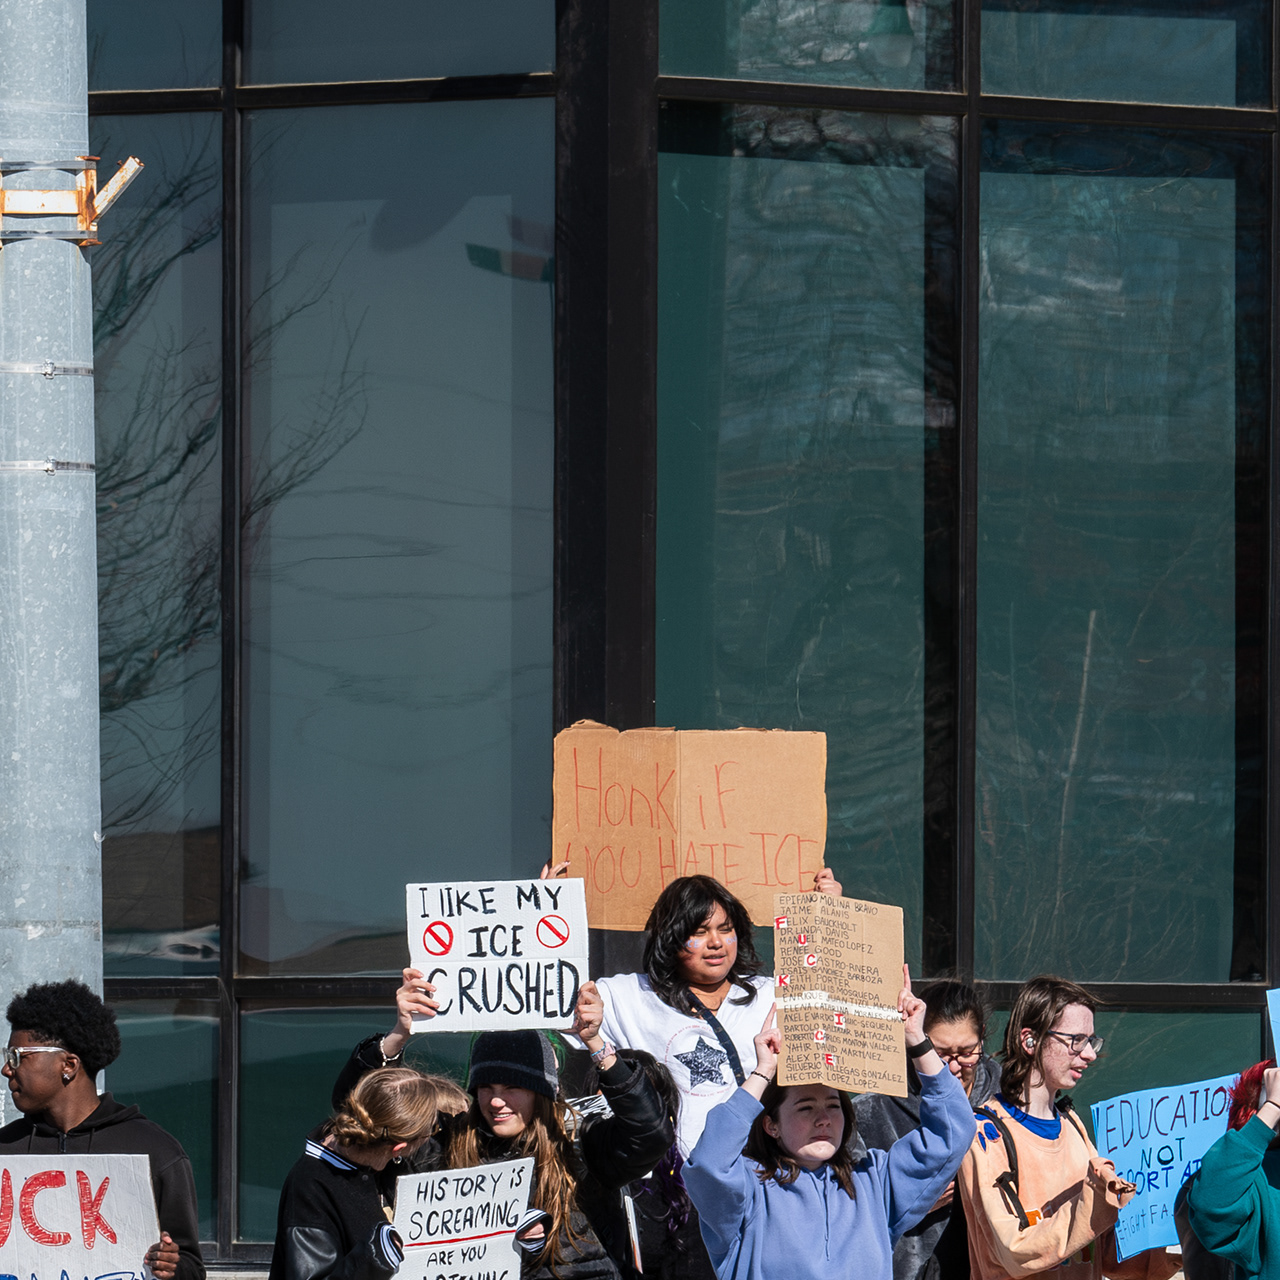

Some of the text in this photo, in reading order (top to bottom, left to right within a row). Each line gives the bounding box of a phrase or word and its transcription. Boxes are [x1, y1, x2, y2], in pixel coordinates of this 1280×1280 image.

[659, 837, 745, 890] HATE
[749, 832, 819, 893] ICE
[419, 887, 430, 918] I
[516, 883, 562, 911] MY
[820, 895, 850, 910] MOLINA
[855, 902, 878, 915] BRAVO
[780, 906, 850, 919] JAIME ALANIS
[775, 916, 809, 930] FELIX
[780, 927, 794, 936] DR
[796, 926, 822, 935] LINDA
[467, 924, 524, 957] ICE
[780, 934, 874, 954] MANUEL MATEO LOPEZ
[780, 956, 803, 967] JOSE
[815, 945, 842, 958] GOOD
[425, 958, 580, 1018] CRUSHED
[779, 974, 851, 988] KEITH PORTER
[783, 984, 806, 993] RYAN
[786, 1054, 812, 1064] ALEX
[786, 1071, 880, 1089] HECTOR LOPEZ LOPEZ
[1106, 1086, 1231, 1154] EDUCATIO
[1140, 1137, 1186, 1171] NOT
[416, 1172, 503, 1205] HISTORY
[409, 1198, 519, 1241] SCREAMING
[427, 1243, 487, 1267] ARE YOU
